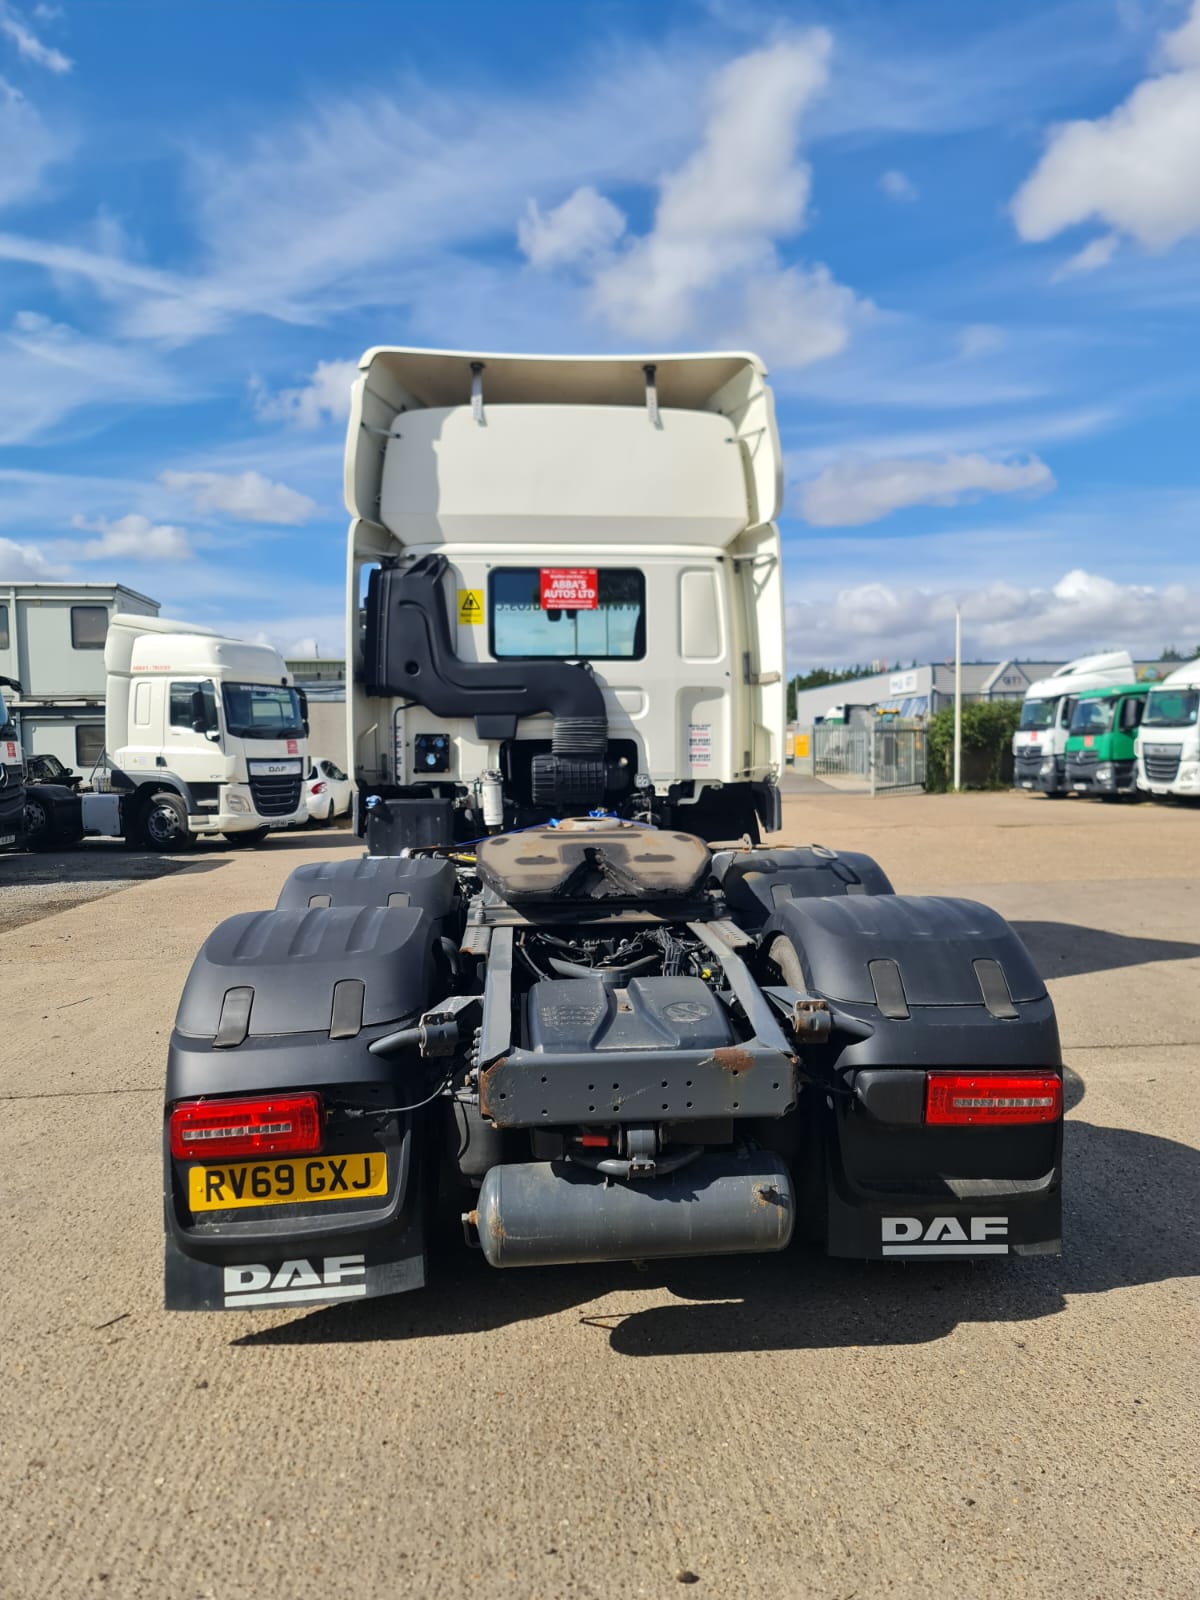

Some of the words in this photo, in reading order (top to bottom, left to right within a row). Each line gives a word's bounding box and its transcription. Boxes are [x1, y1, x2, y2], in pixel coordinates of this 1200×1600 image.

[544, 589, 576, 598] AUTOS
[578, 589, 595, 598] LTD
[552, 580, 587, 589] ABBA'S
[205, 1164, 294, 1203] RV69
[305, 1157, 371, 1193] GXJ
[881, 1217, 1008, 1241] DAF
[224, 1255, 366, 1292] DAF
